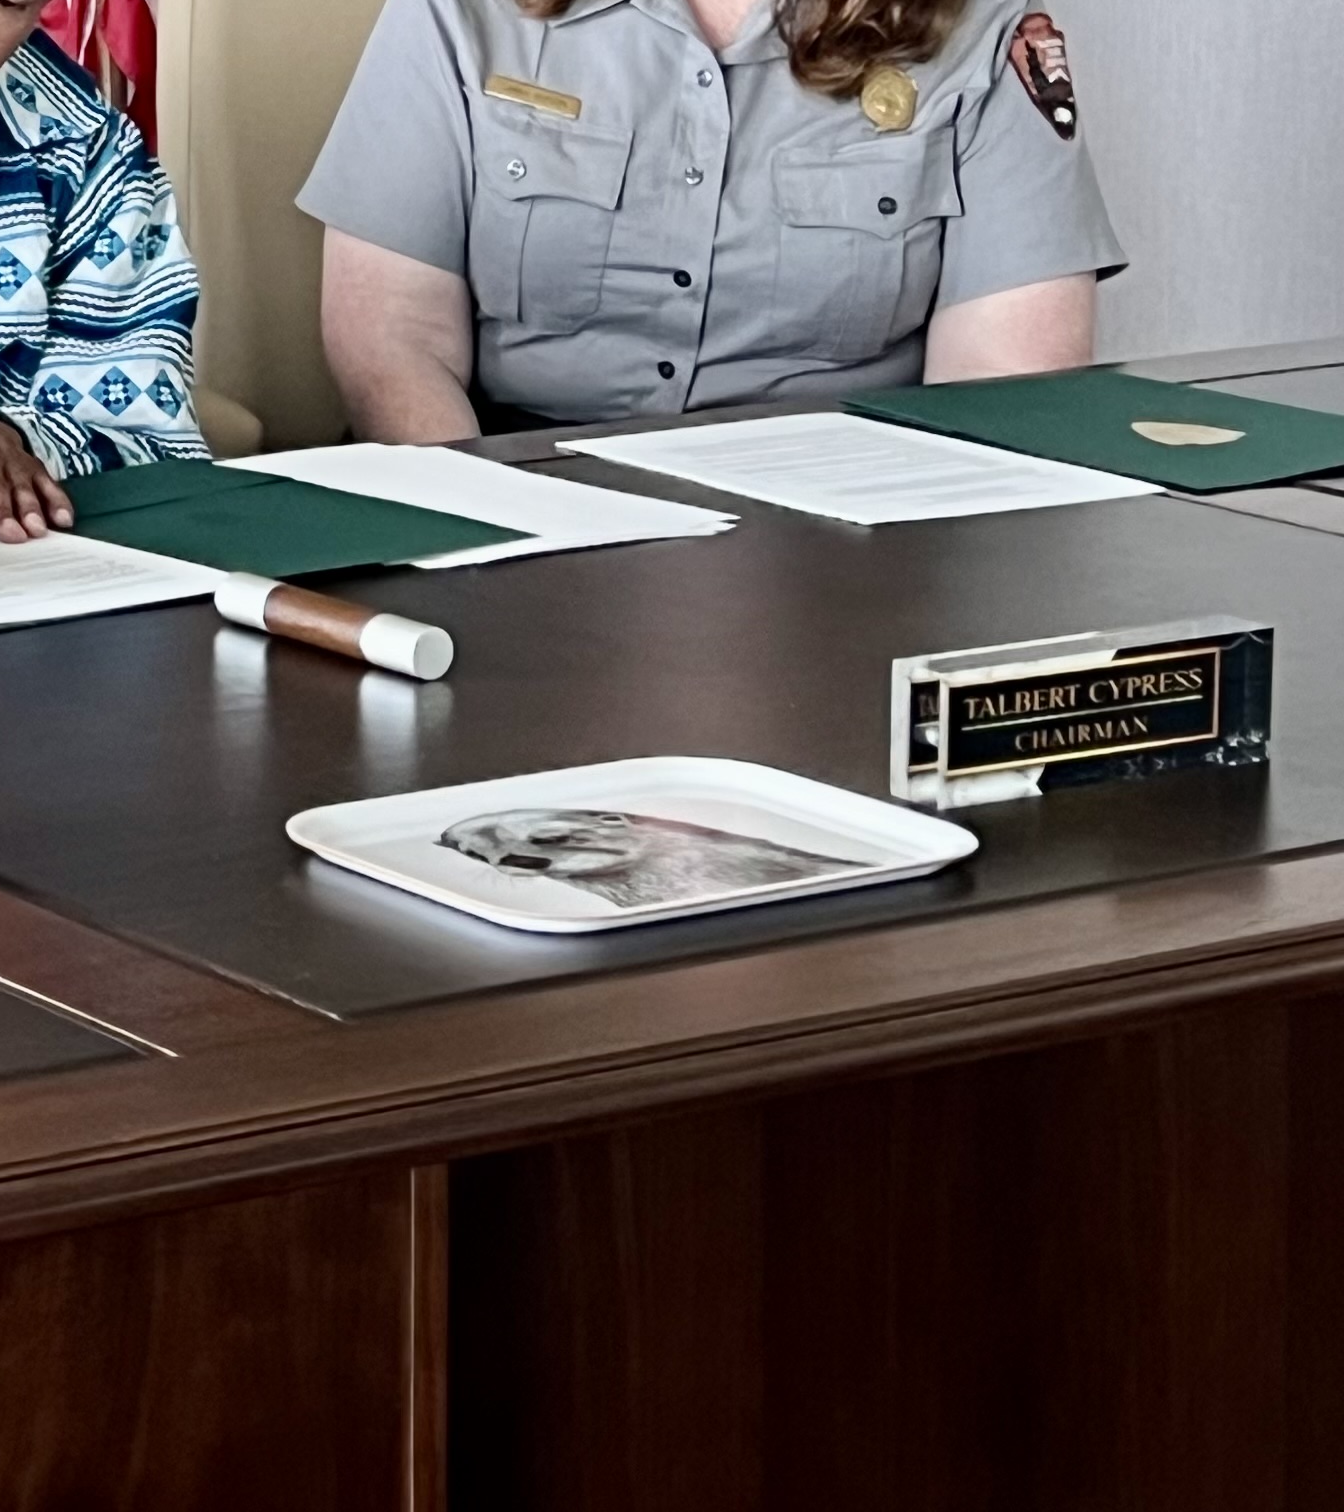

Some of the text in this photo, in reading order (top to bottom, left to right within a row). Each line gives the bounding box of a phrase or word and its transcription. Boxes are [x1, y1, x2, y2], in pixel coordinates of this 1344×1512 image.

[963, 683, 1081, 720] TALBERT
[1088, 668, 1203, 704] CYPRESS
[1014, 714, 1149, 753] CHAIRMAN
